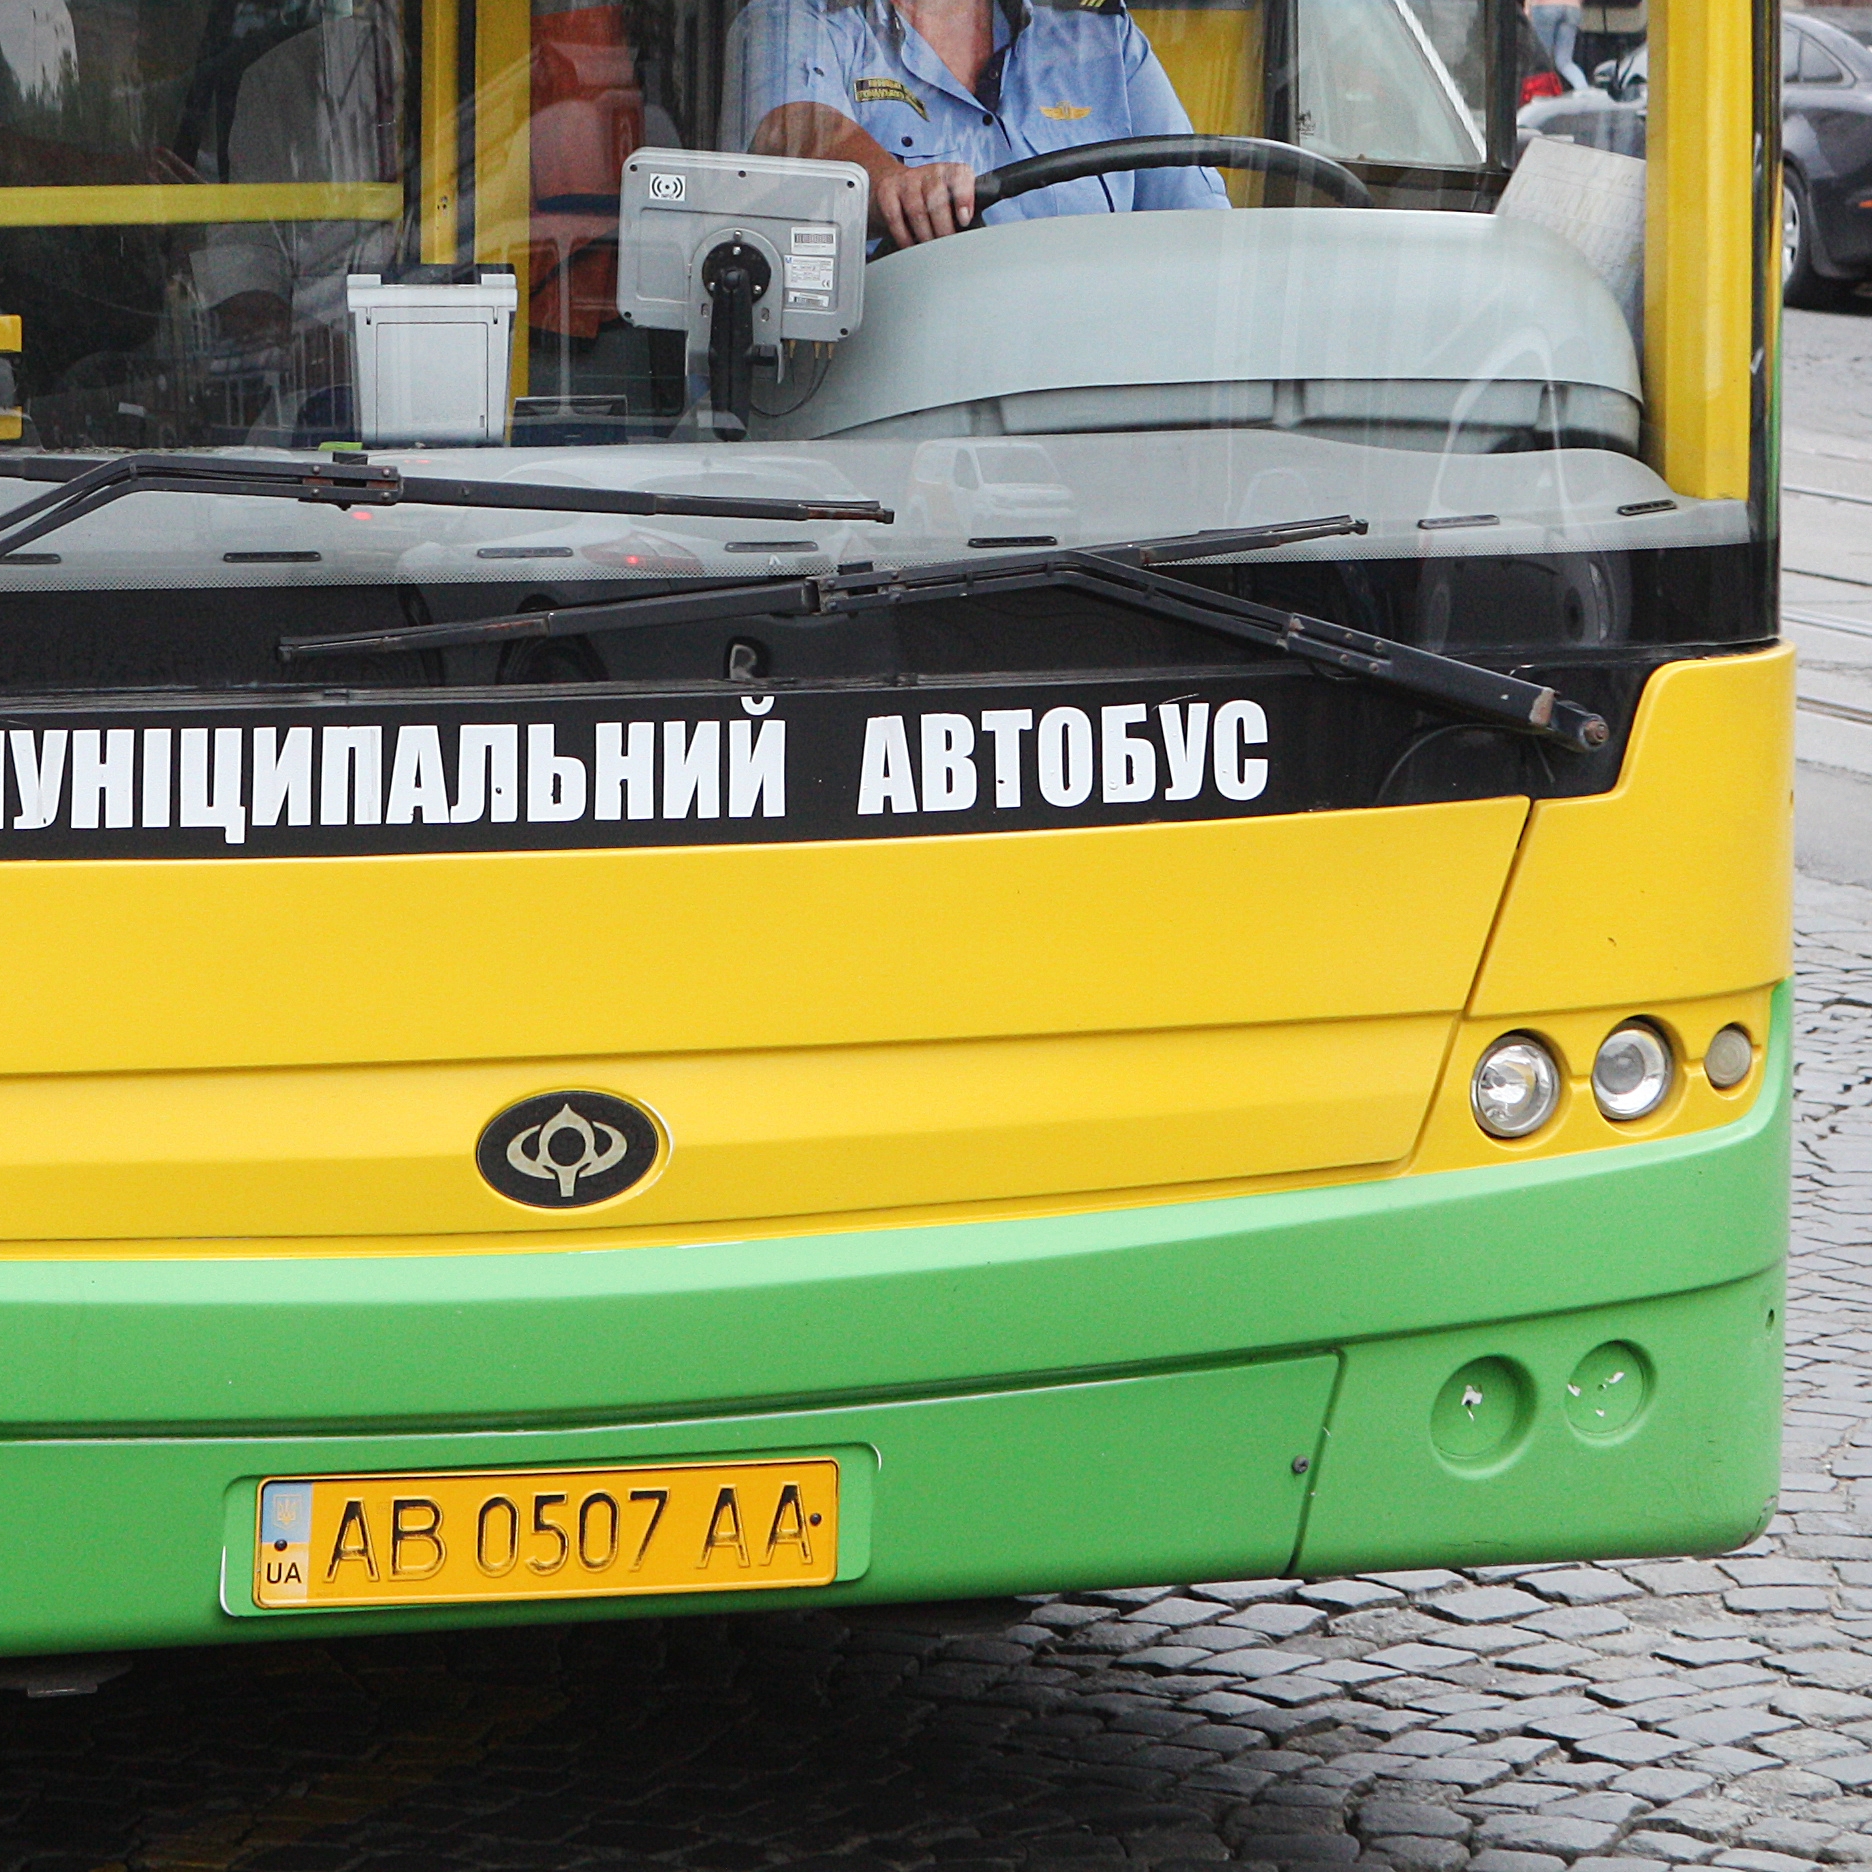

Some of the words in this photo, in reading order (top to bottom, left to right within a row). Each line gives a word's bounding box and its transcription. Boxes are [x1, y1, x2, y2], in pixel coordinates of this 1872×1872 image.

[856, 700, 1271, 816] АВТОБУС
[266, 1561, 302, 1584] UA
[322, 1496, 446, 1583] AB
[475, 1489, 669, 1578] 0507
[695, 1482, 815, 1569] AA
